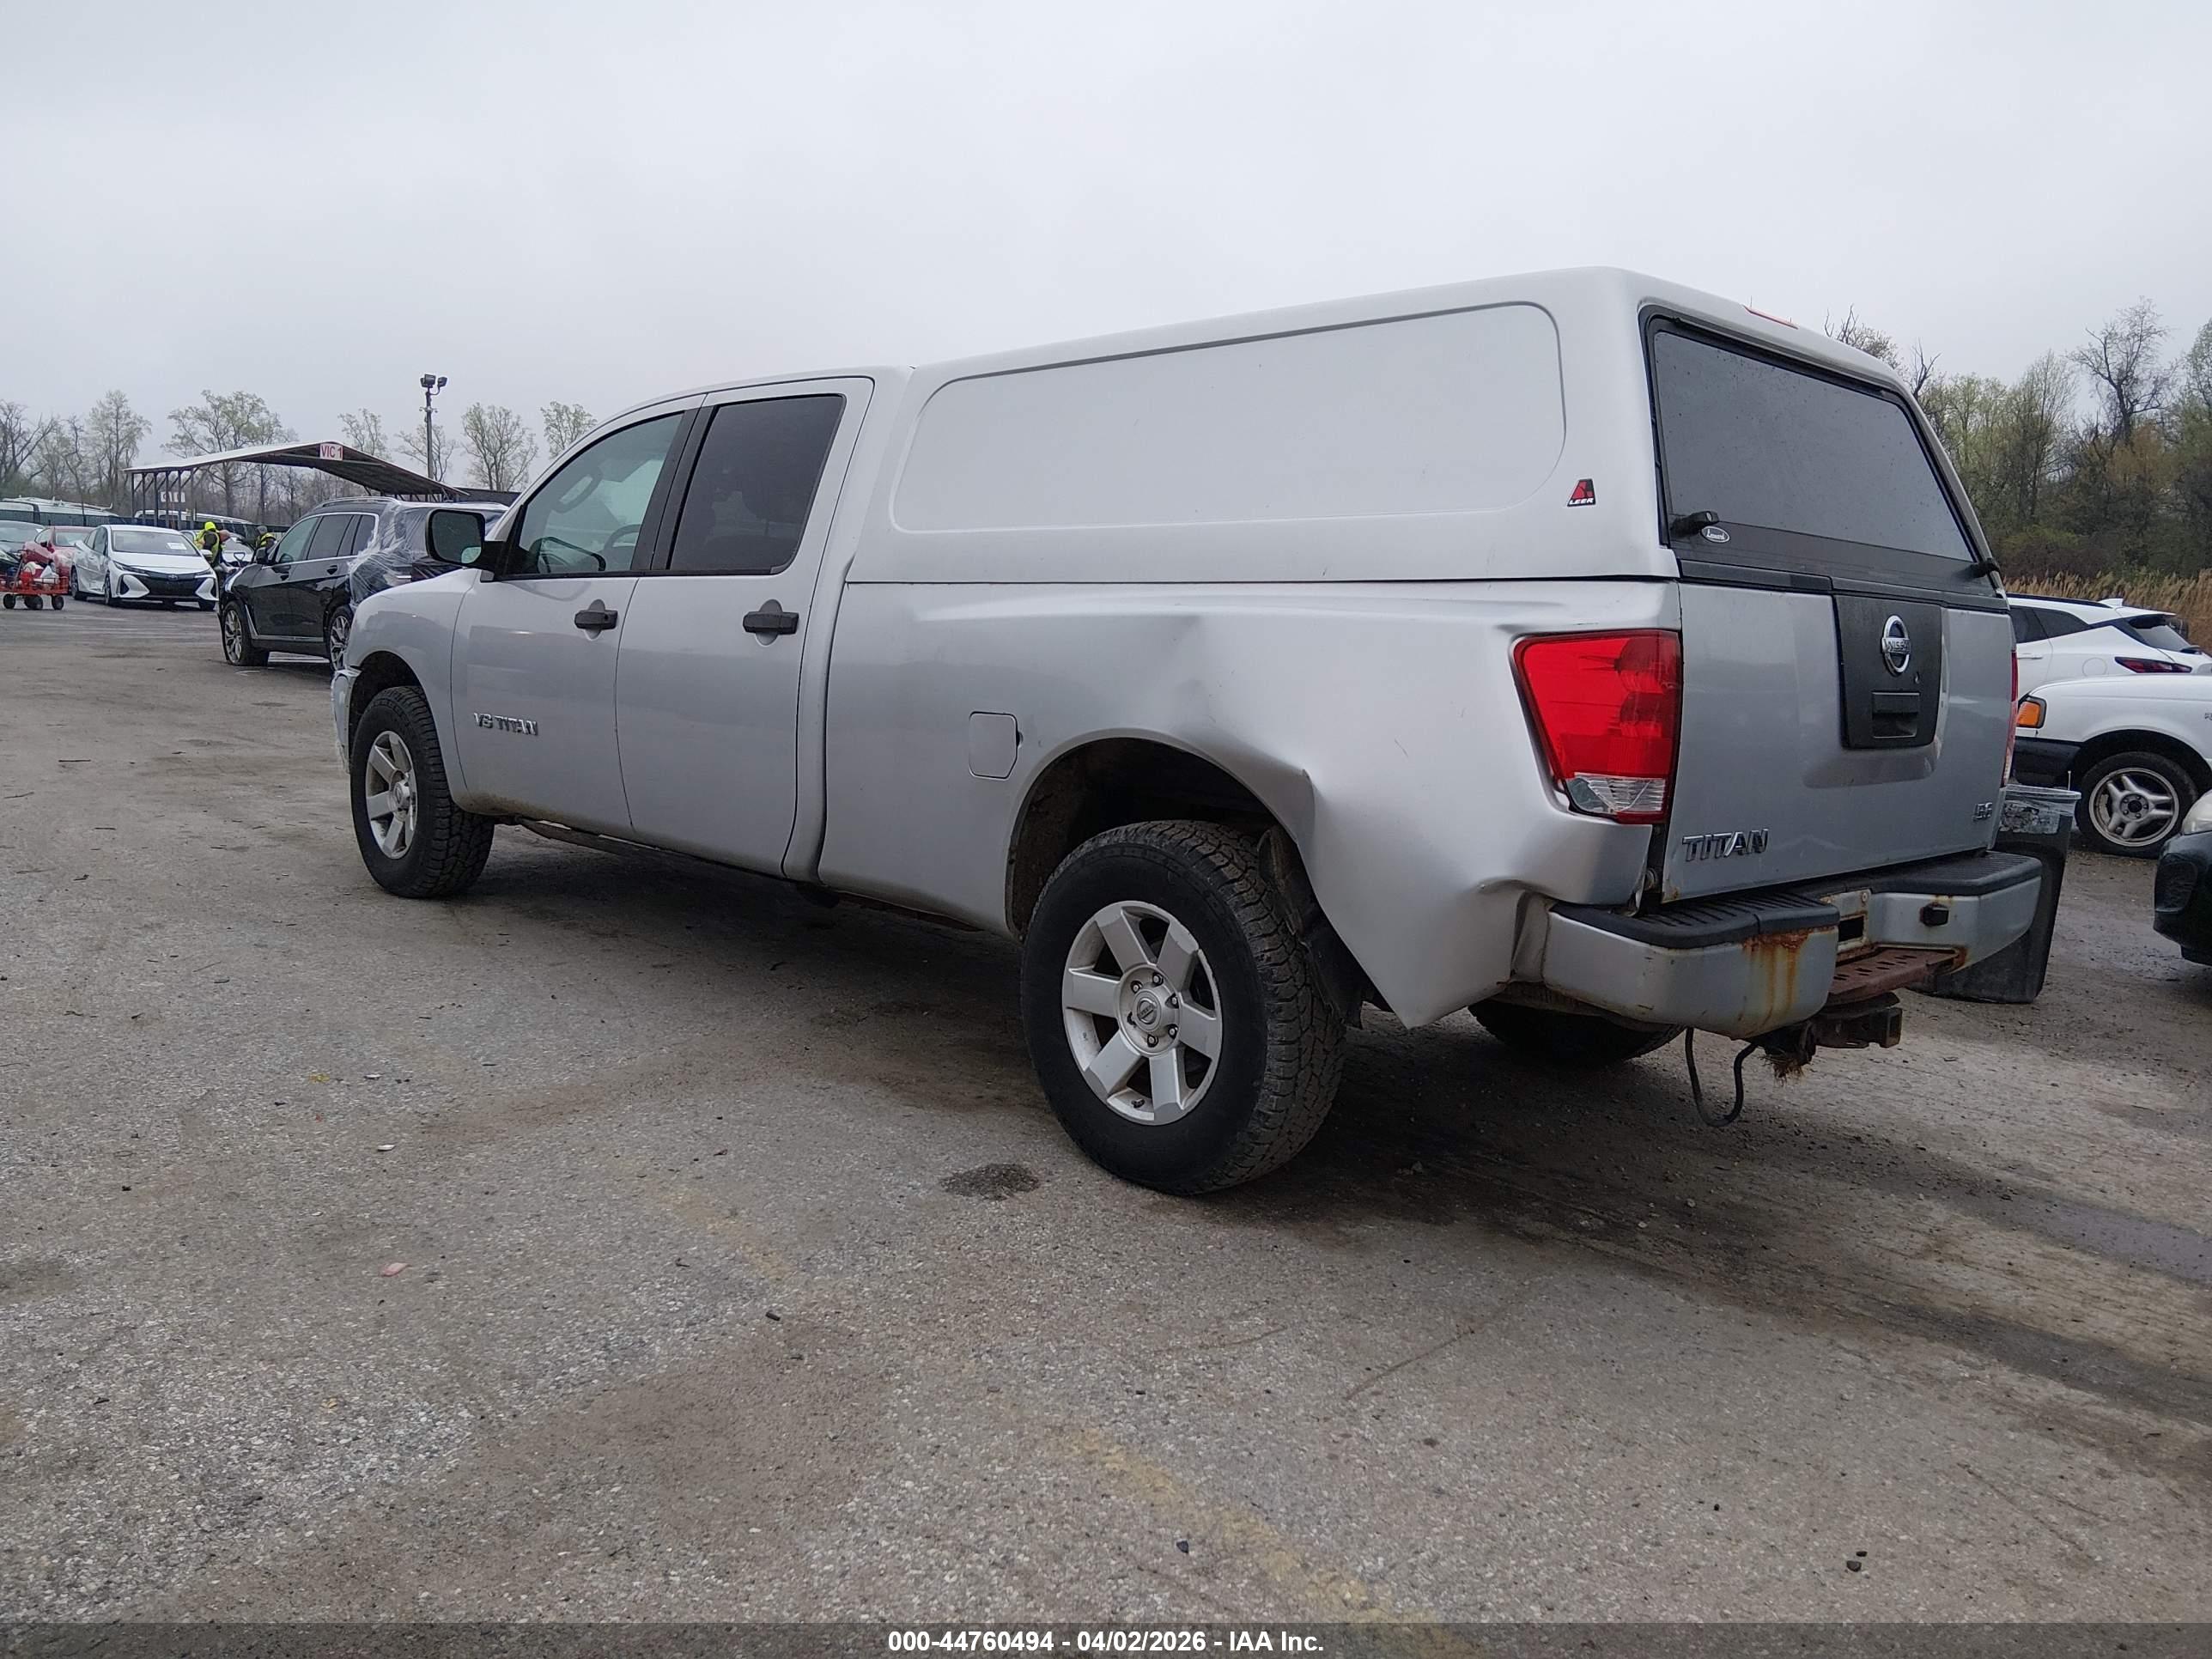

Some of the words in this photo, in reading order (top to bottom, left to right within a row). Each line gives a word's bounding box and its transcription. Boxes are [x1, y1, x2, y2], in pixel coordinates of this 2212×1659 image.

[321, 445, 336, 459] VIC
[337, 447, 342, 459] 1
[494, 715, 538, 736] TITAN
[1682, 829, 1769, 862] TITAN
